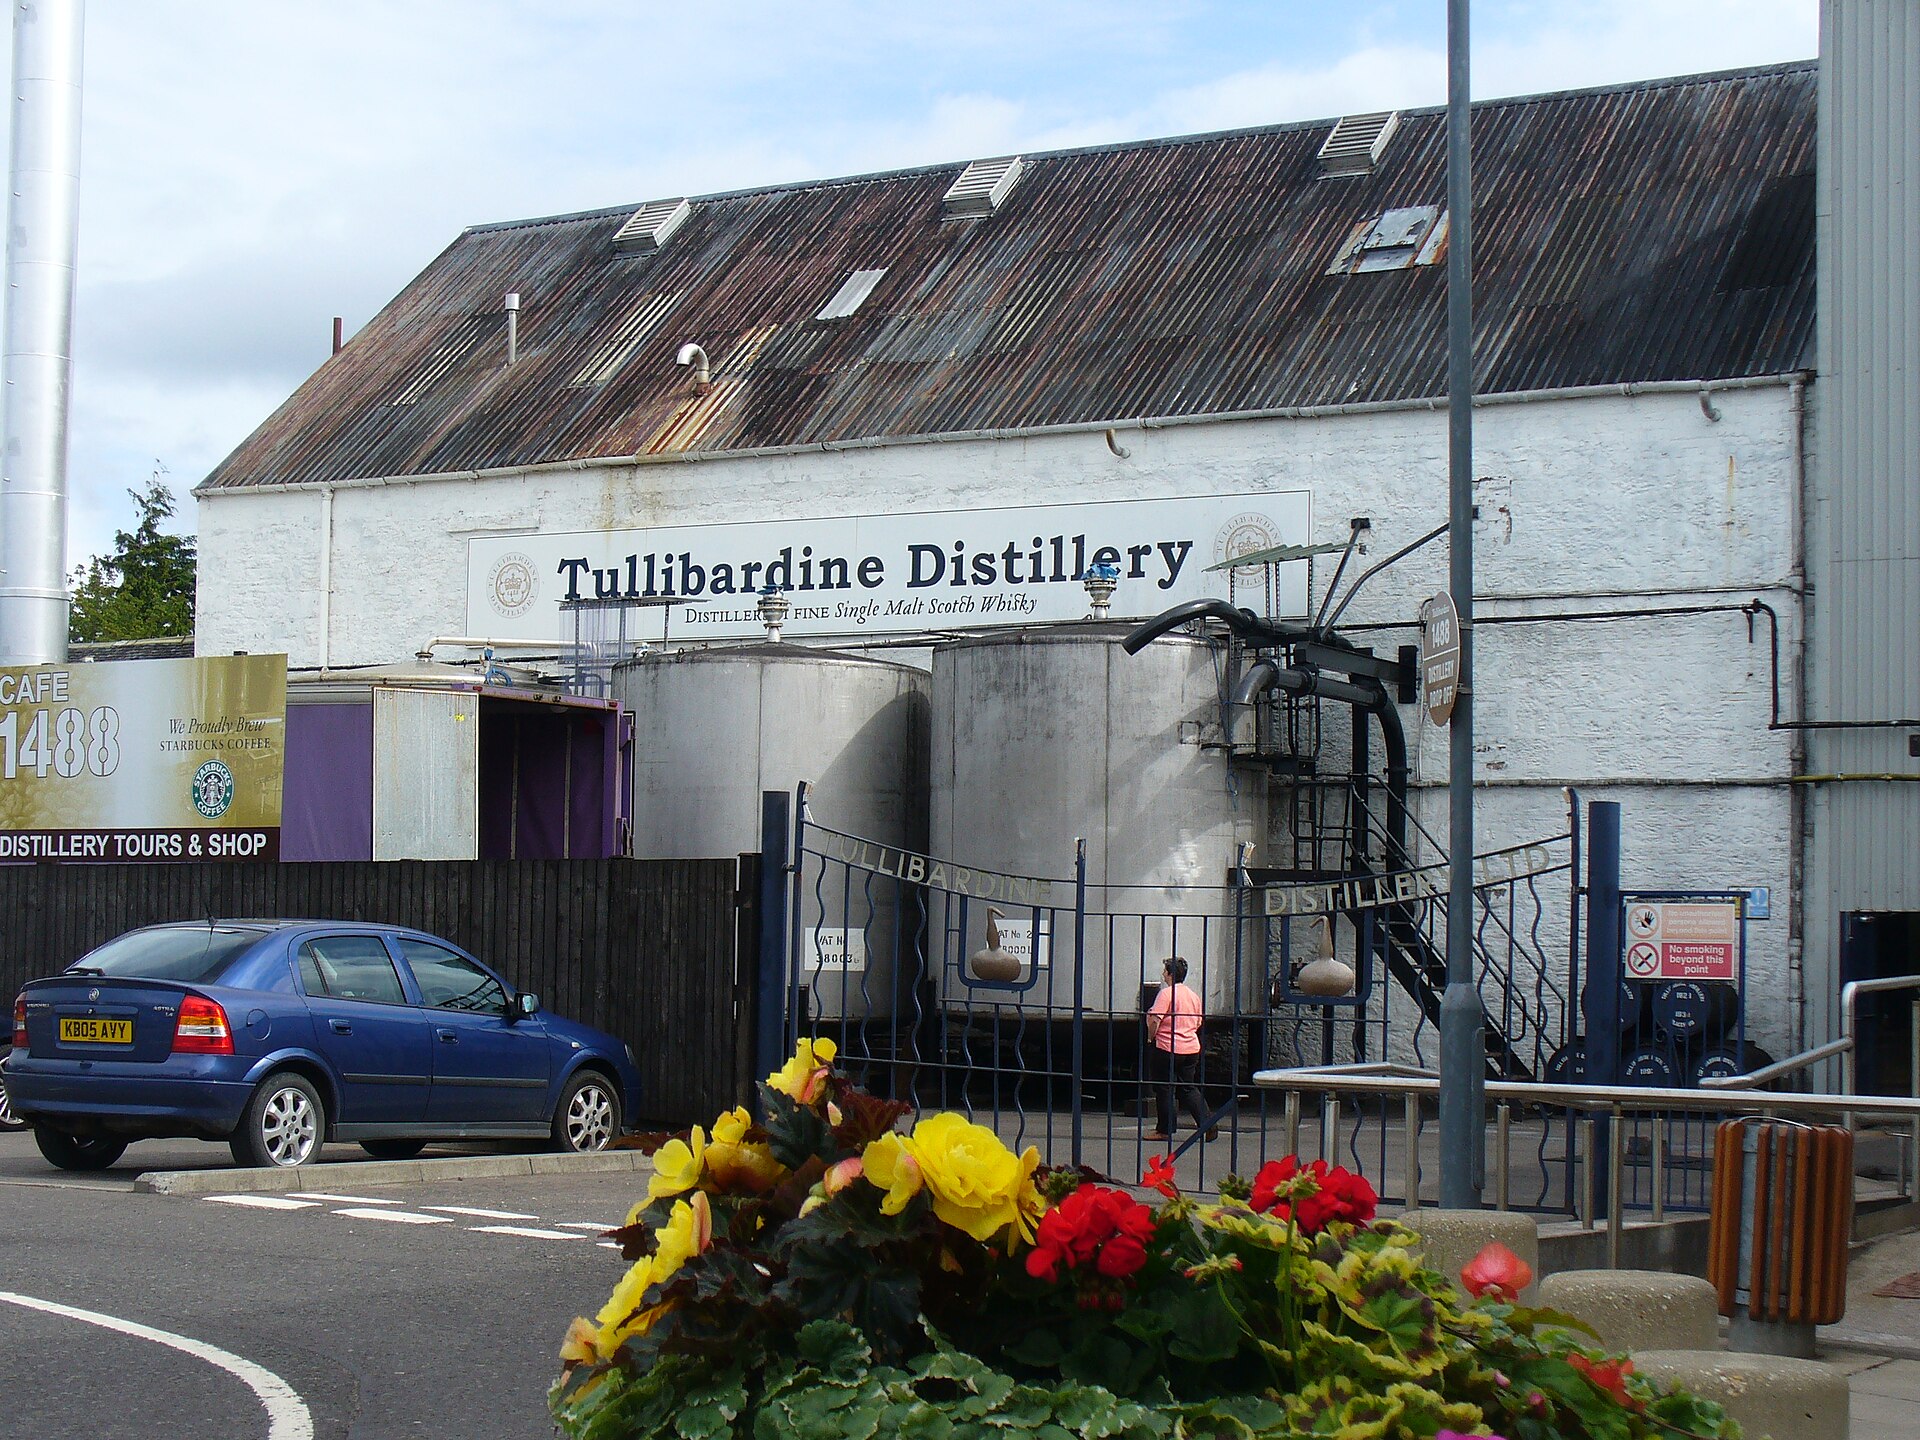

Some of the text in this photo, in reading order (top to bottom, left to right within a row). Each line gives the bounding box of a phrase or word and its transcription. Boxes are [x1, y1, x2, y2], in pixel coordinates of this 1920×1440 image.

[557, 534, 1194, 600] Tullibardine Distillery
[685, 608, 768, 624] DISTILLER
[794, 607, 830, 620] FINE
[835, 599, 880, 624] Single
[883, 597, 925, 616] Malt
[928, 595, 975, 614] Scotch
[981, 593, 1038, 614] Whisky
[1432, 619, 1450, 648] 1488
[0, 671, 69, 704] CAFE
[169, 716, 266, 736] We Proudly Brew
[0, 706, 120, 779] 1488
[160, 738, 271, 751] STARBUCKS COFFEE
[193, 763, 232, 787] STARBUCKS
[197, 801, 226, 815] COFFEE
[0, 832, 267, 857] DISTILLERY TOURS & SHOP
[820, 829, 1052, 904] TULLIBARDINE
[1481, 845, 1550, 885] LTD
[1669, 945, 1725, 955] No smoking
[1669, 955, 1724, 965] beyond this
[1684, 965, 1709, 974] point
[65, 1021, 126, 1039] KB05 AVY
